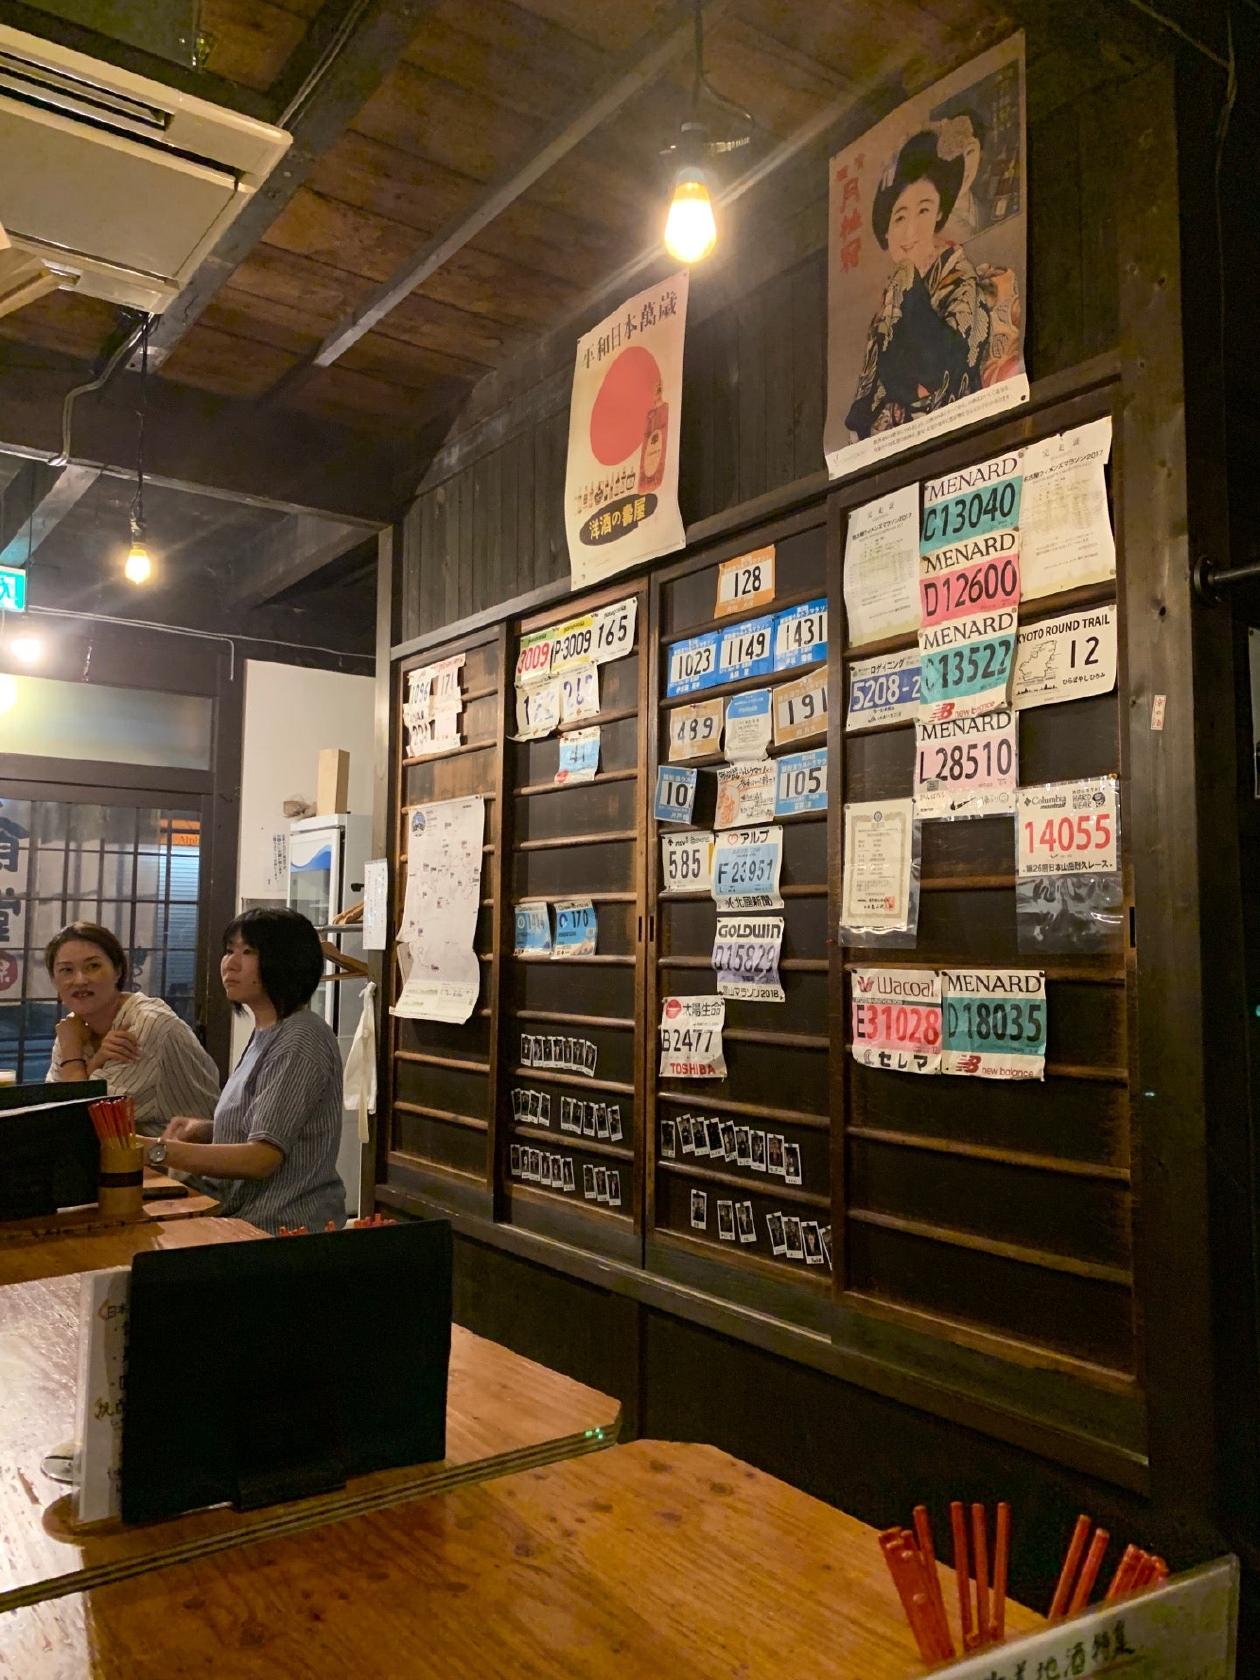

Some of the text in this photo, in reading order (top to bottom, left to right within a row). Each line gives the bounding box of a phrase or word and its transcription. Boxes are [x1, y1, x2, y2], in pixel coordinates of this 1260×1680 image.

[928, 457, 1018, 502] MENARD
[923, 482, 1016, 542] C13040
[924, 533, 1016, 574] MENARD
[734, 565, 762, 598] 128
[923, 560, 1018, 617] D12600
[597, 614, 629, 649] 165
[786, 614, 823, 651] 1431
[923, 613, 1014, 650] MENARD
[1017, 613, 1110, 645] KYOTO ROUND TRAIL
[517, 641, 550, 674] 3009
[678, 647, 711, 680] 1023
[728, 632, 765, 666] 1149
[925, 639, 1012, 692] C13522
[1070, 636, 1100, 668] 12
[788, 687, 828, 726] 191
[677, 716, 713, 743] 489
[920, 711, 1012, 741] MENARD
[919, 738, 1012, 785] L28510
[667, 782, 689, 807] 10
[1024, 813, 1111, 855] 14055
[669, 849, 701, 880] 585
[877, 976, 934, 998] Wacoal
[948, 974, 1042, 993] MENARD
[856, 1004, 940, 1046] E31028
[947, 1002, 1042, 1043] D18035
[662, 1028, 714, 1053] B2477
[670, 1062, 716, 1076] TOSHIBA
[879, 1050, 929, 1072] セレマ
[982, 1066, 1035, 1078] new balance
